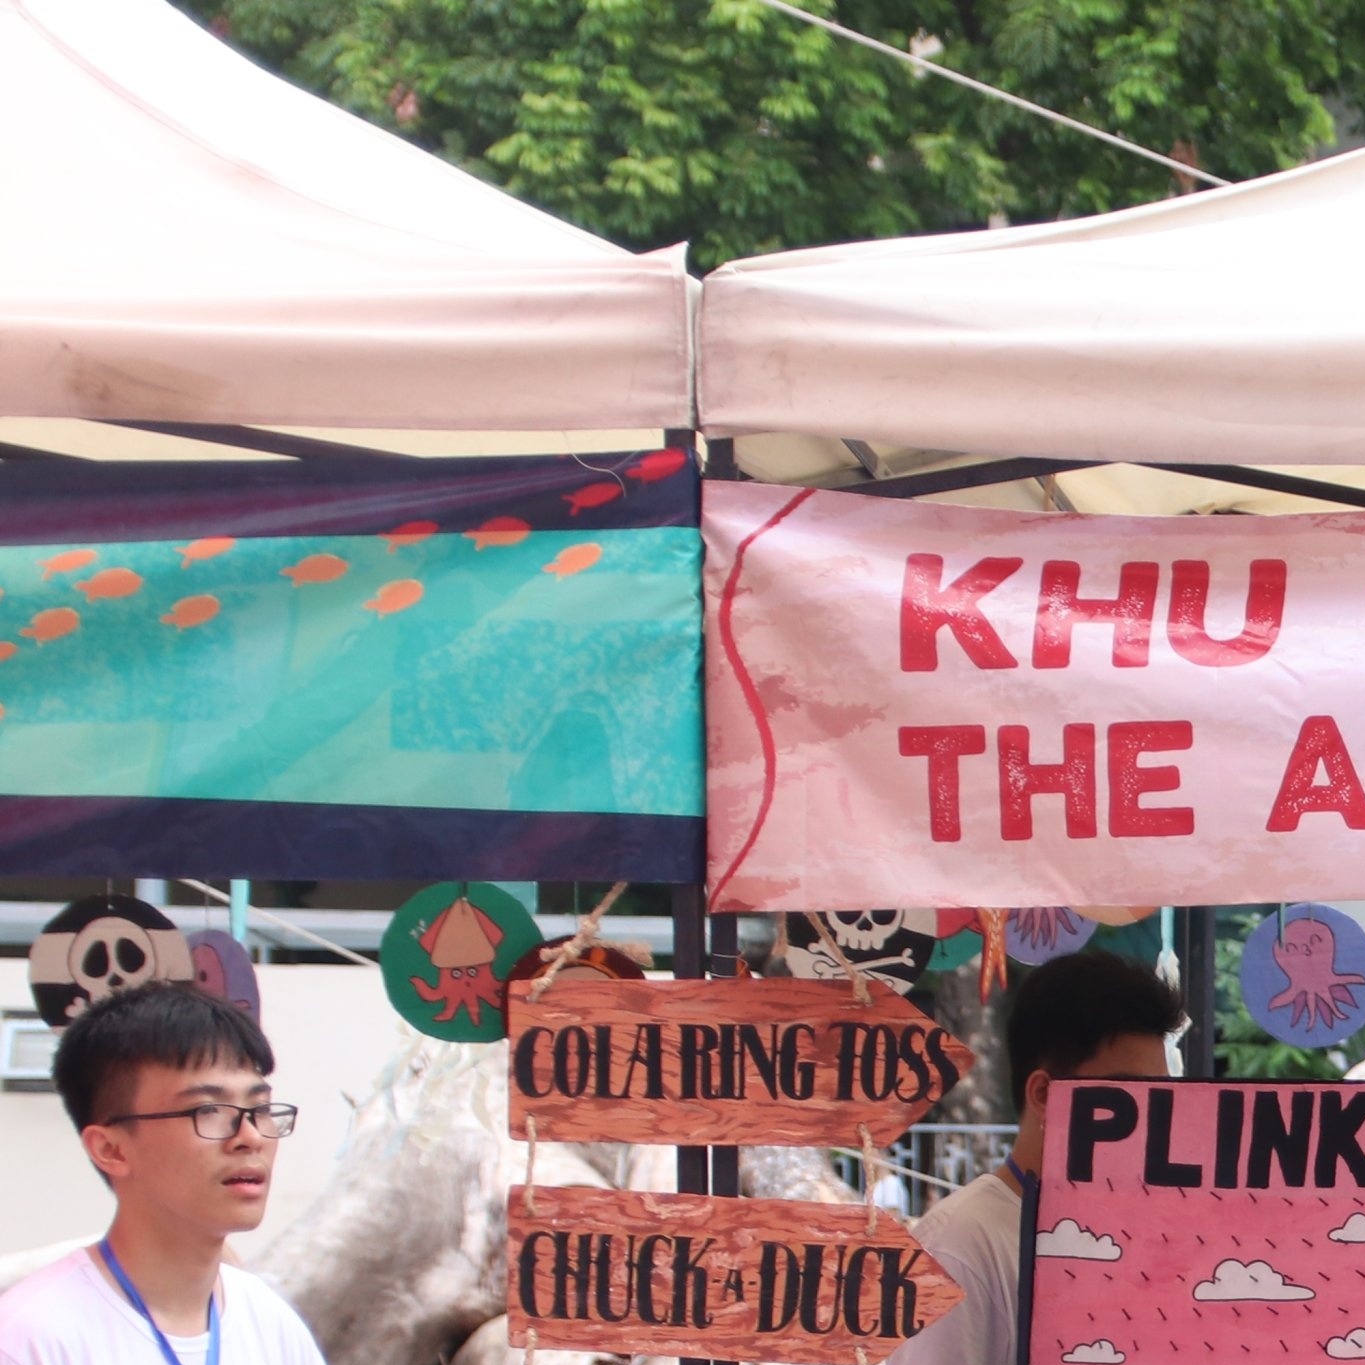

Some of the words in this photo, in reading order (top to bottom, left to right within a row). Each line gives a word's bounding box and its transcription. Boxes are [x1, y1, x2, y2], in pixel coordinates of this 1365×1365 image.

[900, 552, 1287, 671] KHU
[898, 720, 1195, 842] THE
[513, 1023, 663, 1100] COLA
[678, 1022, 816, 1101] RING
[829, 1021, 960, 1104] TOSS
